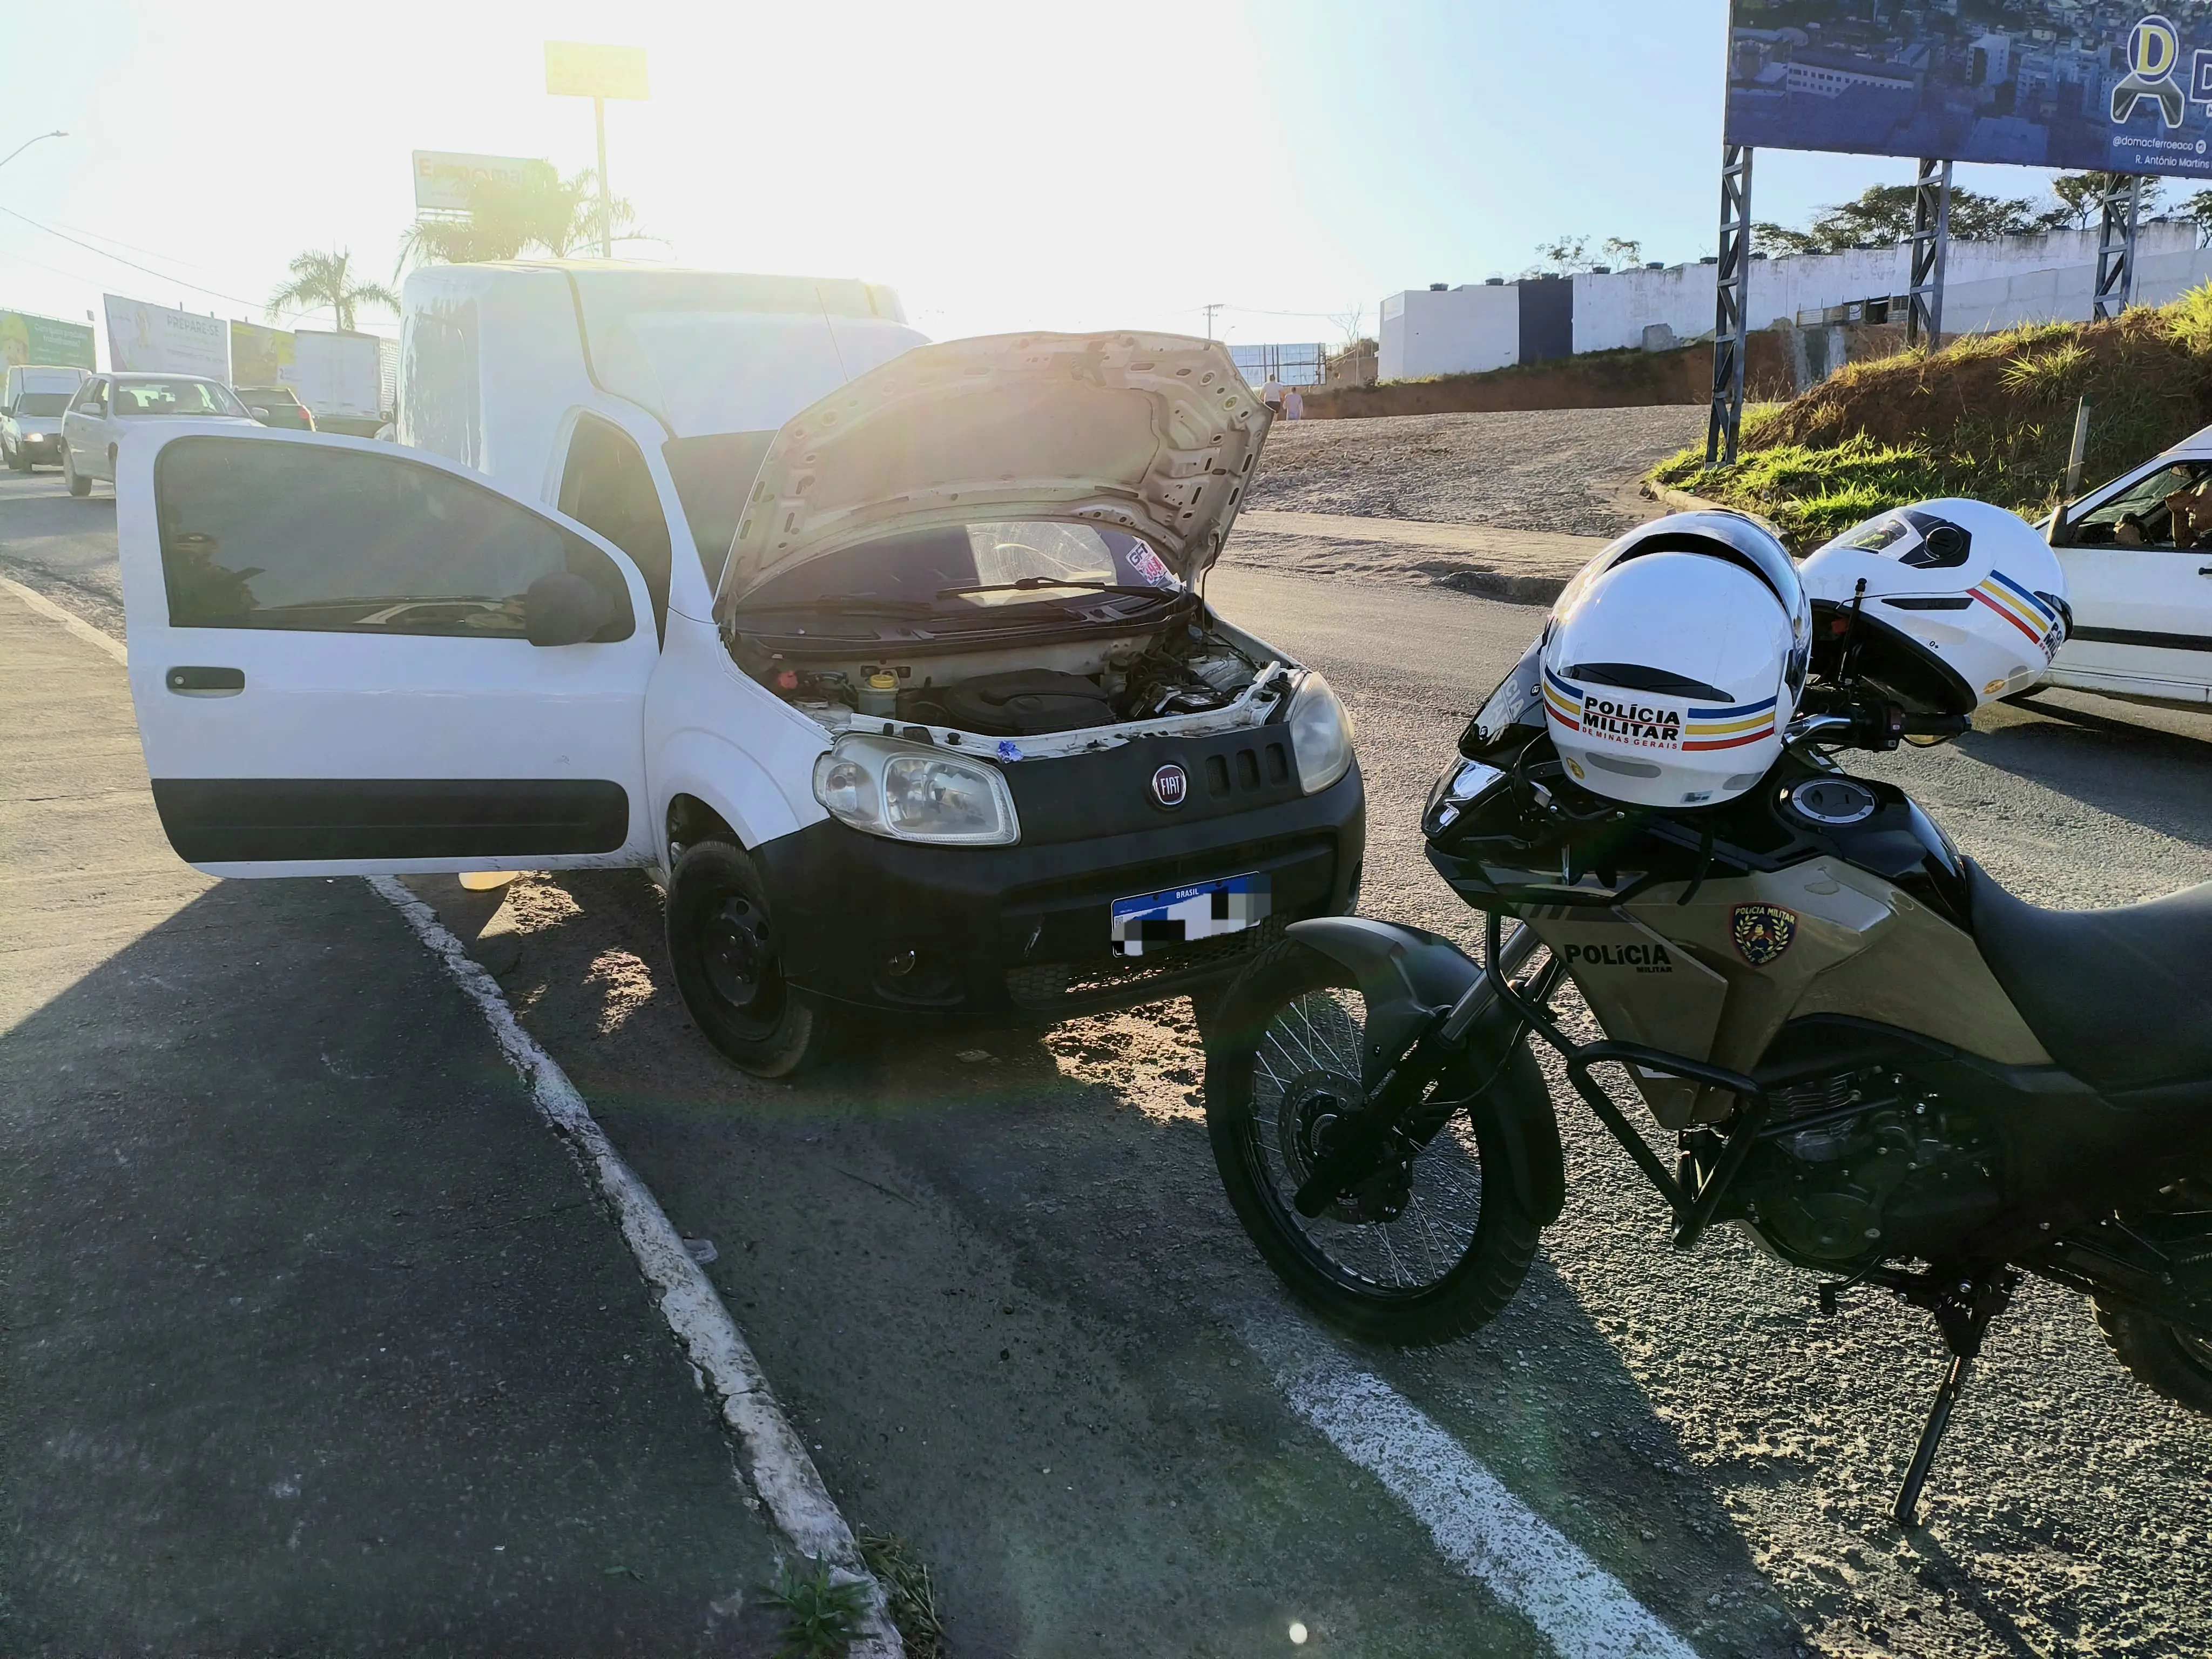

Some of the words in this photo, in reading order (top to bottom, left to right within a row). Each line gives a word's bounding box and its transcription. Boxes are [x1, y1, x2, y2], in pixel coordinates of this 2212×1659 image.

[2113, 136, 2193, 150] @domacferroeaco
[2135, 154, 2142, 164] R.
[2179, 158, 2209, 168] Martins
[167, 314, 219, 336] PREPARE-SE
[1585, 696, 1680, 725] POLÍCIA
[1583, 712, 1678, 740] MILITAR
[1582, 726, 1593, 735] DE
[1596, 731, 1629, 744] MINAS
[1634, 739, 1677, 750] GERAIS
[1160, 775, 1180, 795] FIAT
[1176, 888, 1199, 899] BRASIL
[1768, 908, 1795, 925] MILITAR
[1564, 944, 1671, 965] POLÍCIA
